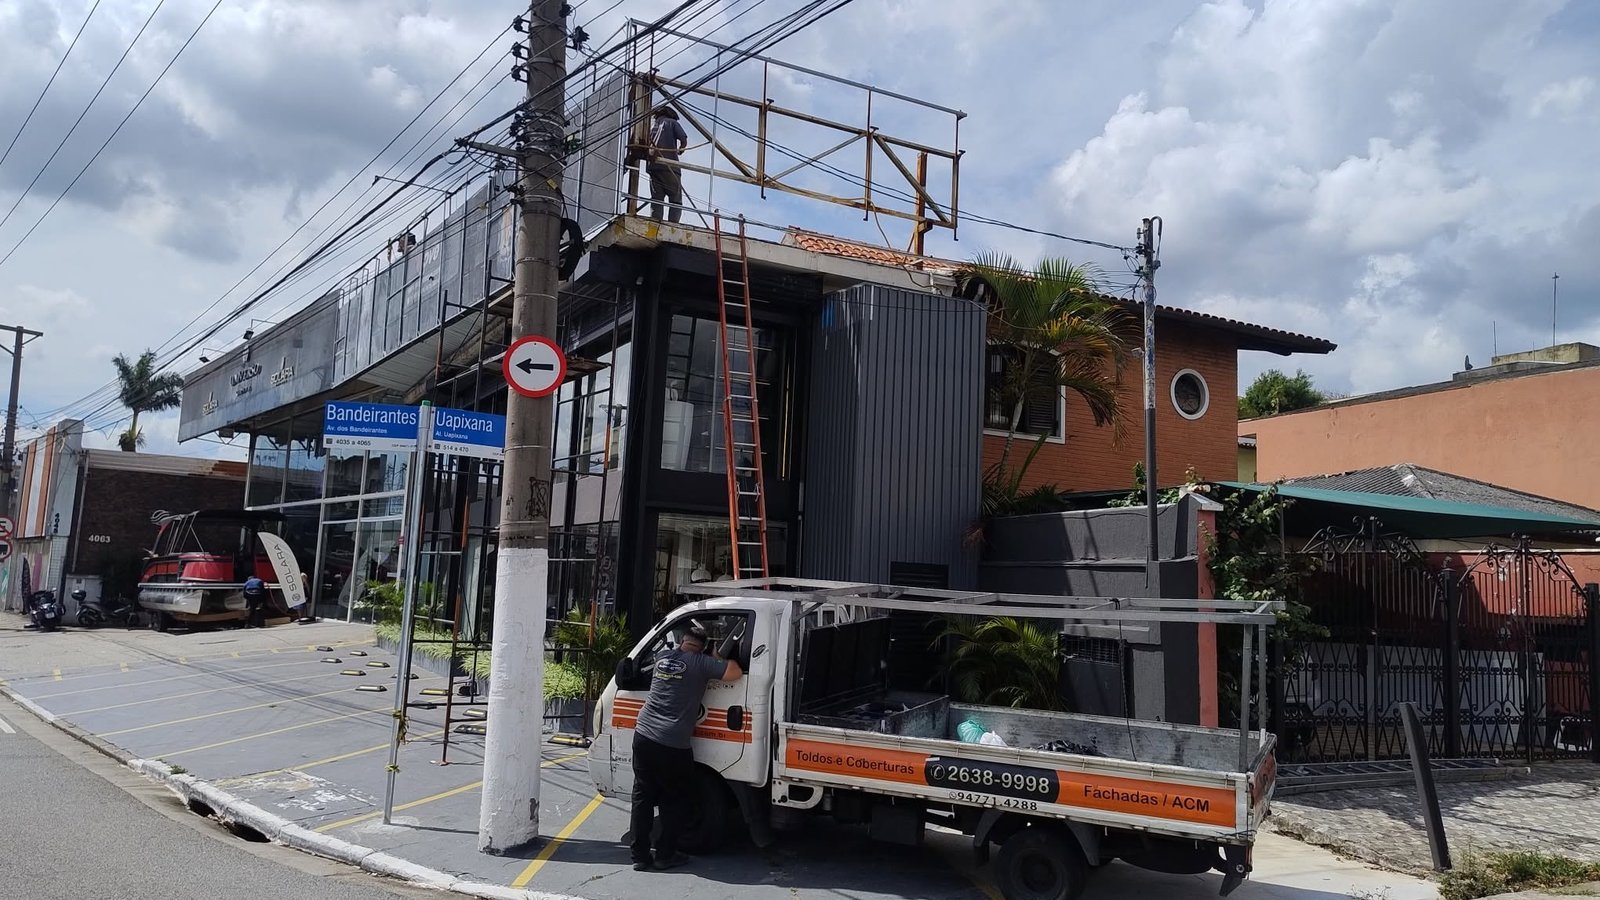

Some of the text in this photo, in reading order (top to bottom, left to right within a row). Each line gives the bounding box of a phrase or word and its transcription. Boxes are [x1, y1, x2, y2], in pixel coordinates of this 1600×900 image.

[326, 404, 417, 425] Bandeirantes
[436, 412, 493, 433] Uapixana
[349, 426, 388, 434] Bandeirantes
[443, 431, 469, 440] Uapixana
[88, 534, 111, 543] 4063
[273, 543, 297, 592] SOLARA
[796, 749, 914, 775] Toldos e Coberturas
[948, 765, 1050, 794] 2638-9998
[957, 791, 1038, 811] 94771.4288
[1084, 784, 1158, 806] Fachadas
[1172, 796, 1210, 813] ACM
